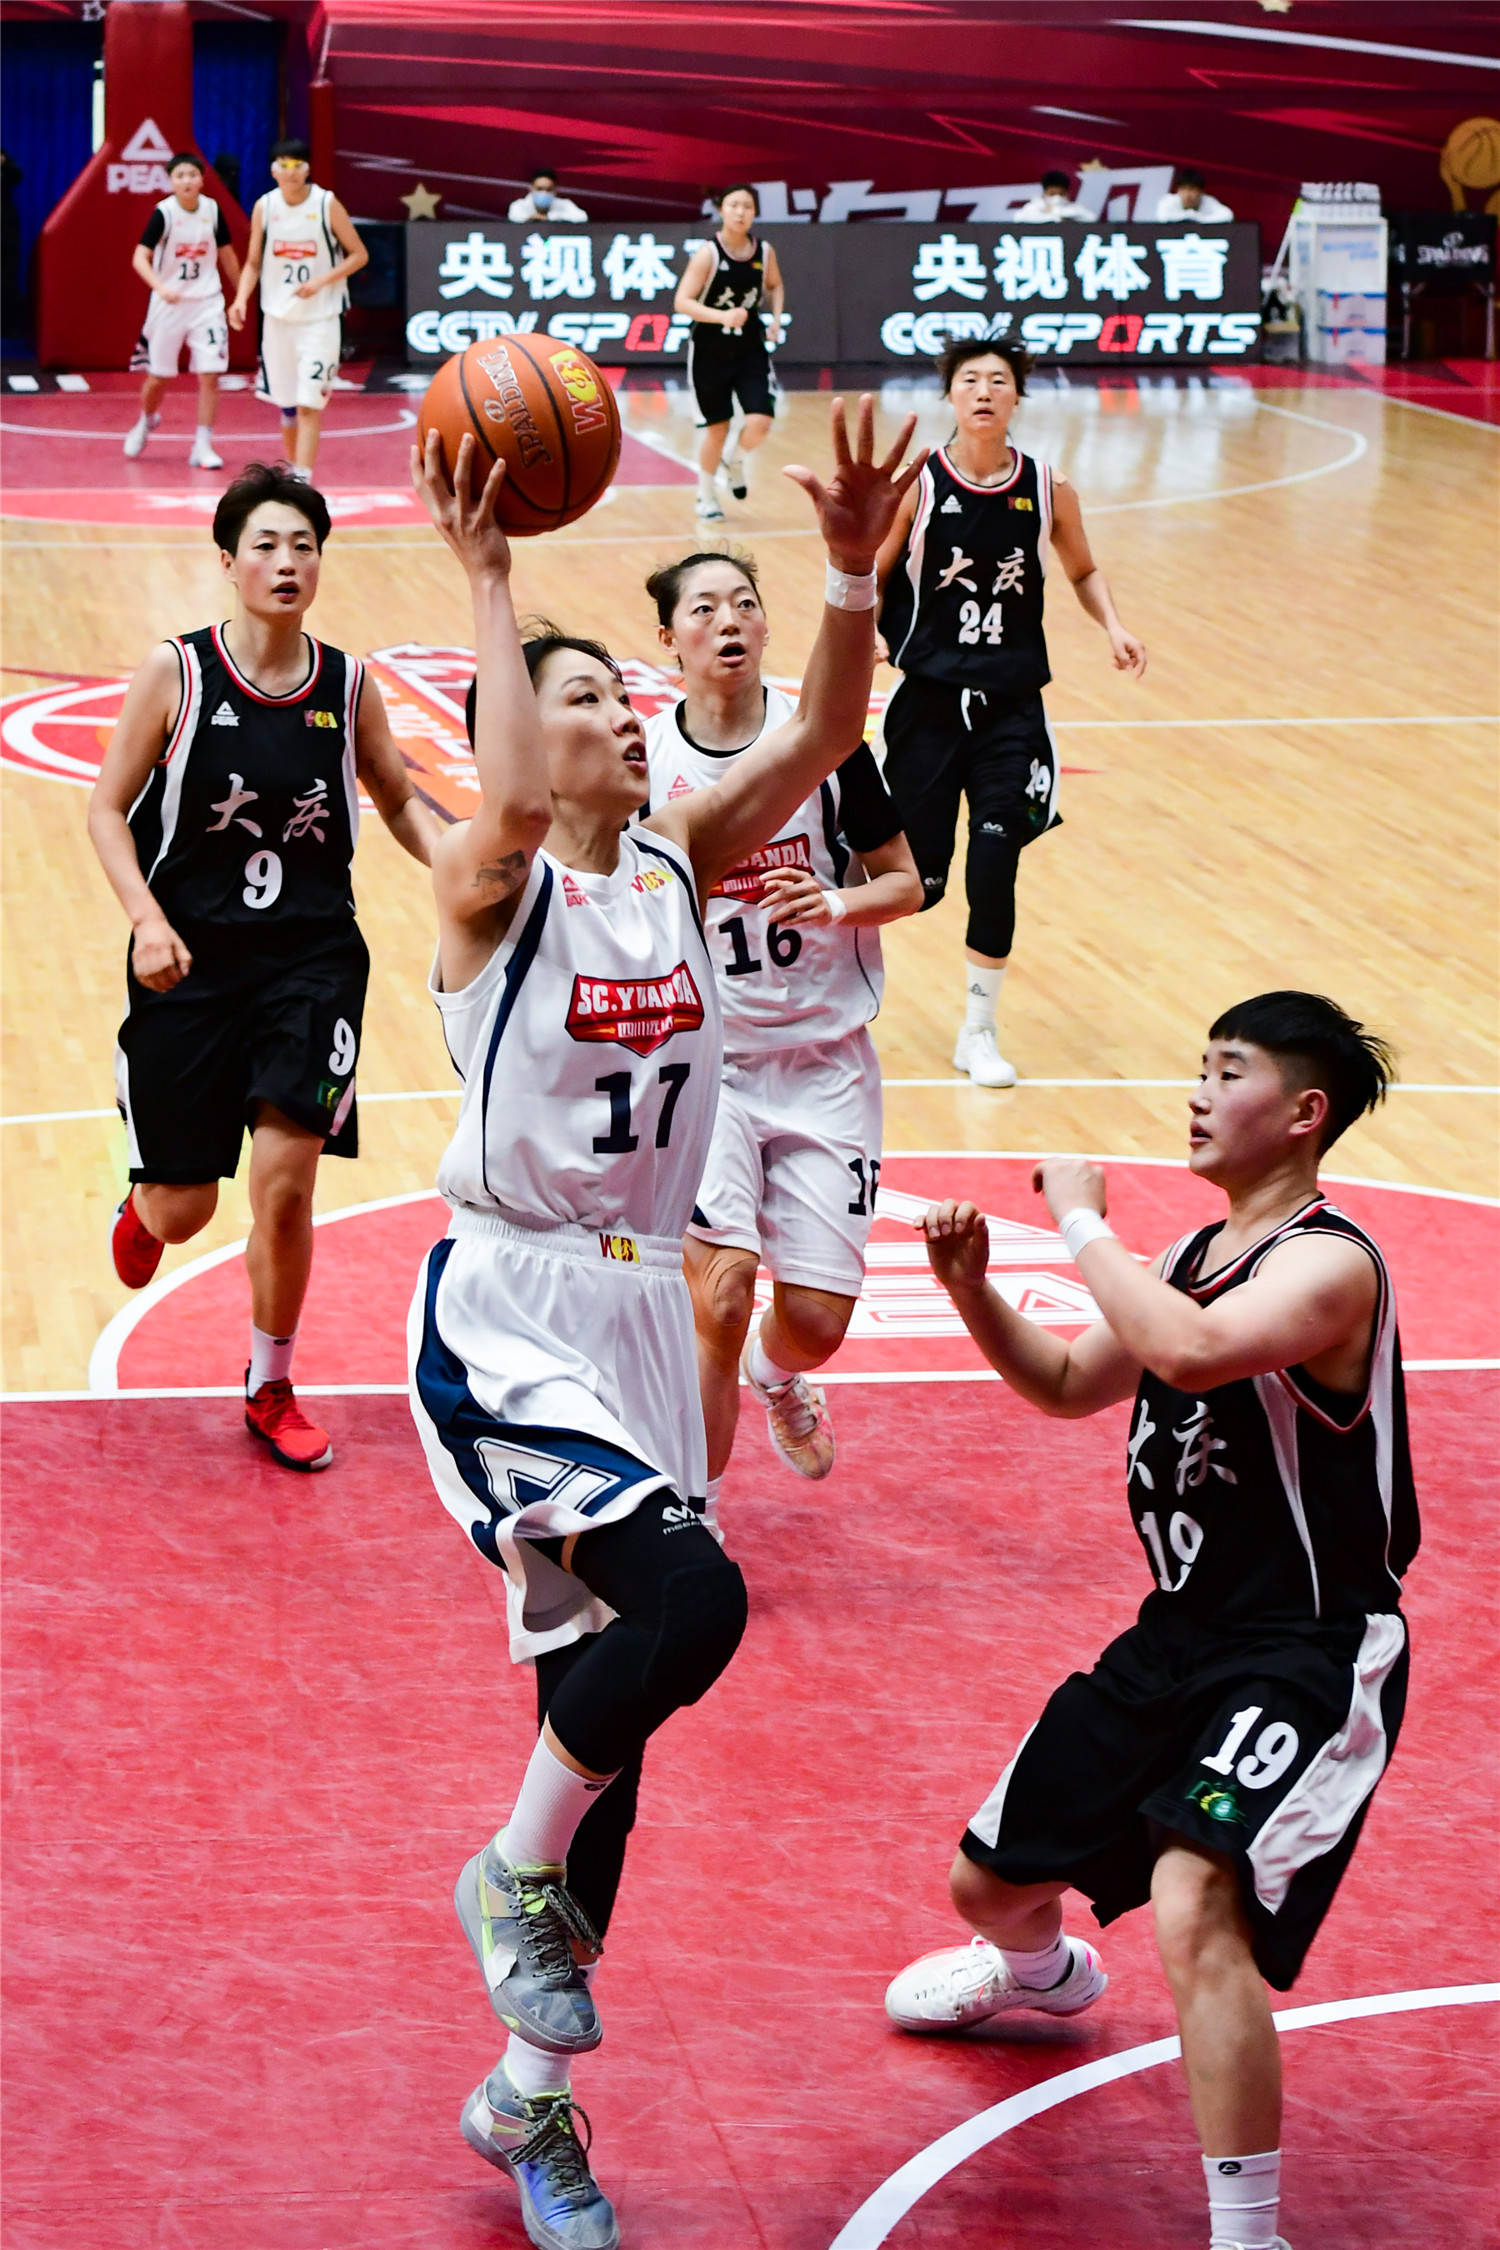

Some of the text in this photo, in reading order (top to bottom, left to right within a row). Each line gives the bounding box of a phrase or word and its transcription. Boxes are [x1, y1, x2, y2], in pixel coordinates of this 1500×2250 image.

[107, 165, 172, 193] PEA
[179, 262, 201, 280] 13
[284, 264, 311, 284] 20
[438, 231, 704, 300] 央视体
[913, 233, 1229, 301] 央视体育
[1020, 312, 1262, 354] SPORTS
[476, 345, 551, 469] SPALDING
[934, 546, 1026, 596] 大庆
[958, 600, 1003, 645] 24
[204, 772, 331, 843] 大庆
[242, 850, 283, 910] 9
[736, 841, 809, 868] ANDA
[718, 916, 802, 976] 16
[577, 969, 698, 1015] SC.YUANDA
[328, 1017, 356, 1076] 9
[593, 1062, 690, 1154] 17
[1126, 1398, 1238, 1496] 大庆
[1140, 1511, 1204, 1592] 19
[1200, 1705, 1299, 1790] 19
